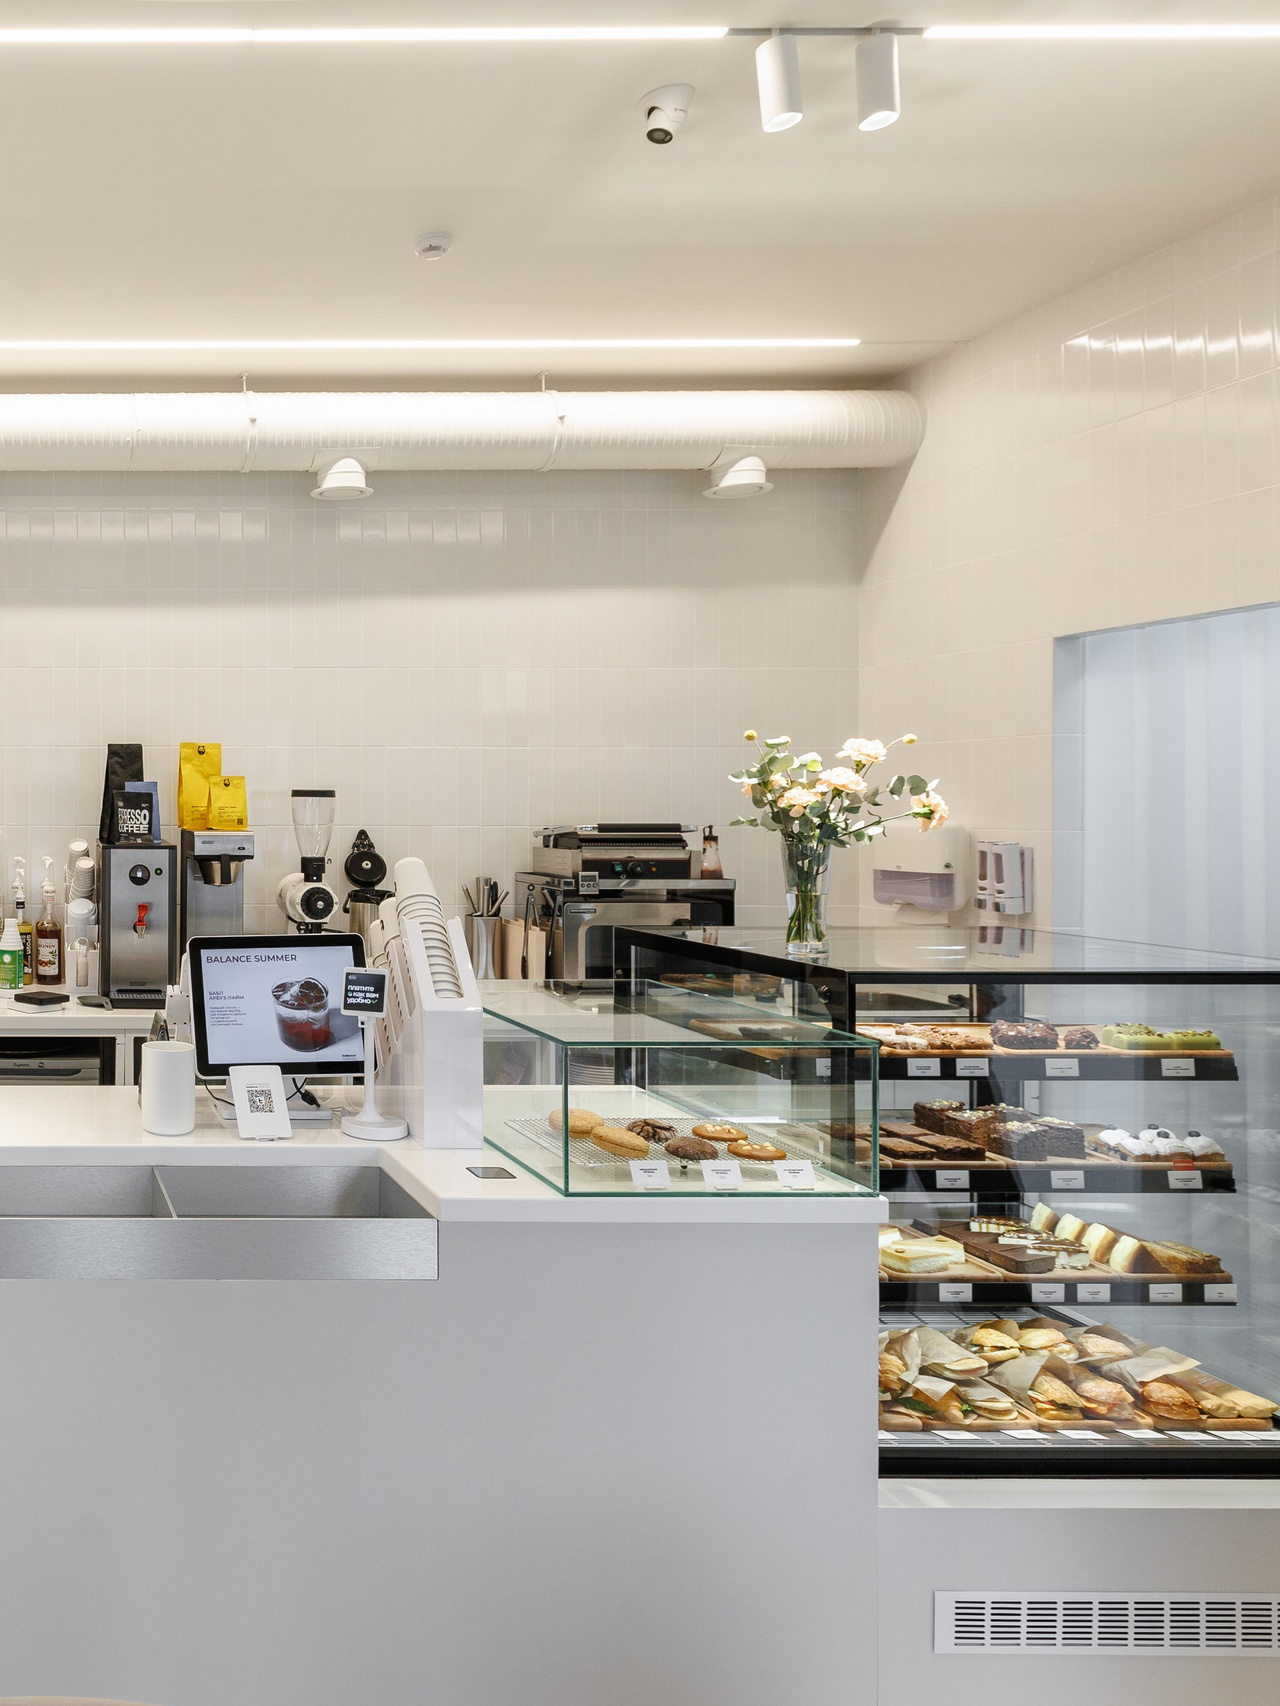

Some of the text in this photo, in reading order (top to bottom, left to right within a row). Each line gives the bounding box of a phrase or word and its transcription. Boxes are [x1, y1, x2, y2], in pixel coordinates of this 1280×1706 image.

[118, 824, 149, 834] COFFEE
[206, 954, 297, 964] BALANCE SUMMER
